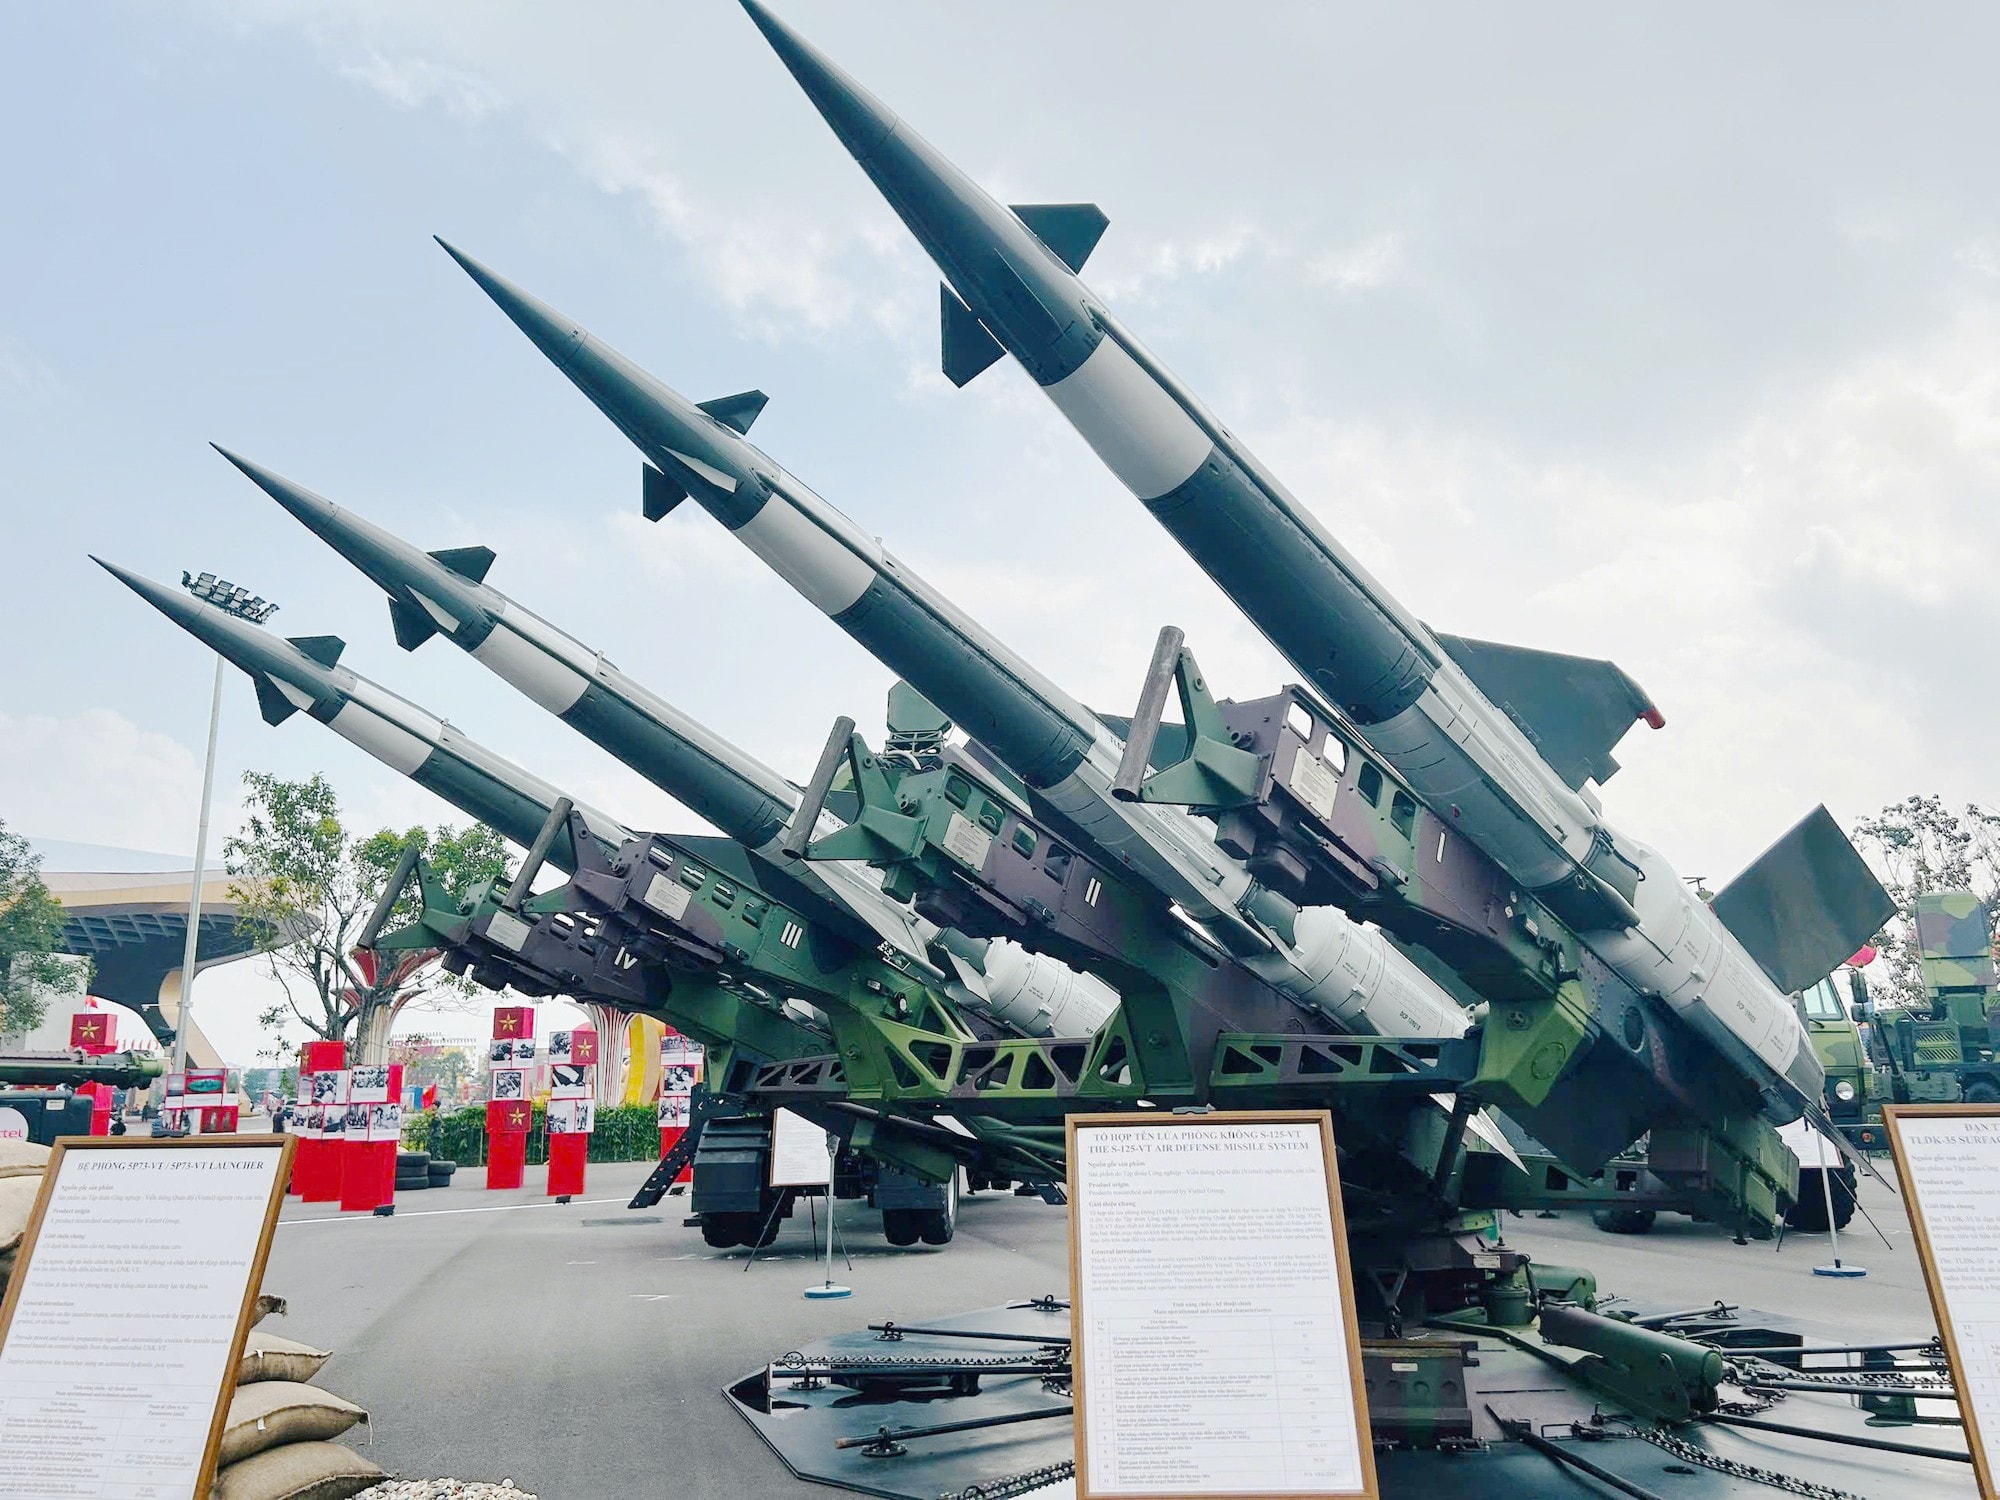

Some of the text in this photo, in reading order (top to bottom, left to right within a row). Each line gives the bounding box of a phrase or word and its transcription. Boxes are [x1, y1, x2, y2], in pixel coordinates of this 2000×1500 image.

[1111, 1132, 1132, 1143] HỢP
[1135, 1130, 1154, 1141] TÊN
[1181, 1129, 1217, 1141] PHÒNG
[1220, 1129, 1258, 1140] KHÔNG
[1259, 1130, 1302, 1140] S-125-VT
[1909, 1135, 1957, 1145] TLDK-35
[1088, 1142, 1310, 1154] THE S-125-VT AIR DEFENSE MISSILE SYSTEM
[127, 1161, 164, 1171] 5P73-VT
[170, 1161, 208, 1171] 5P73-VT
[209, 1161, 264, 1170] LAUNCHER
